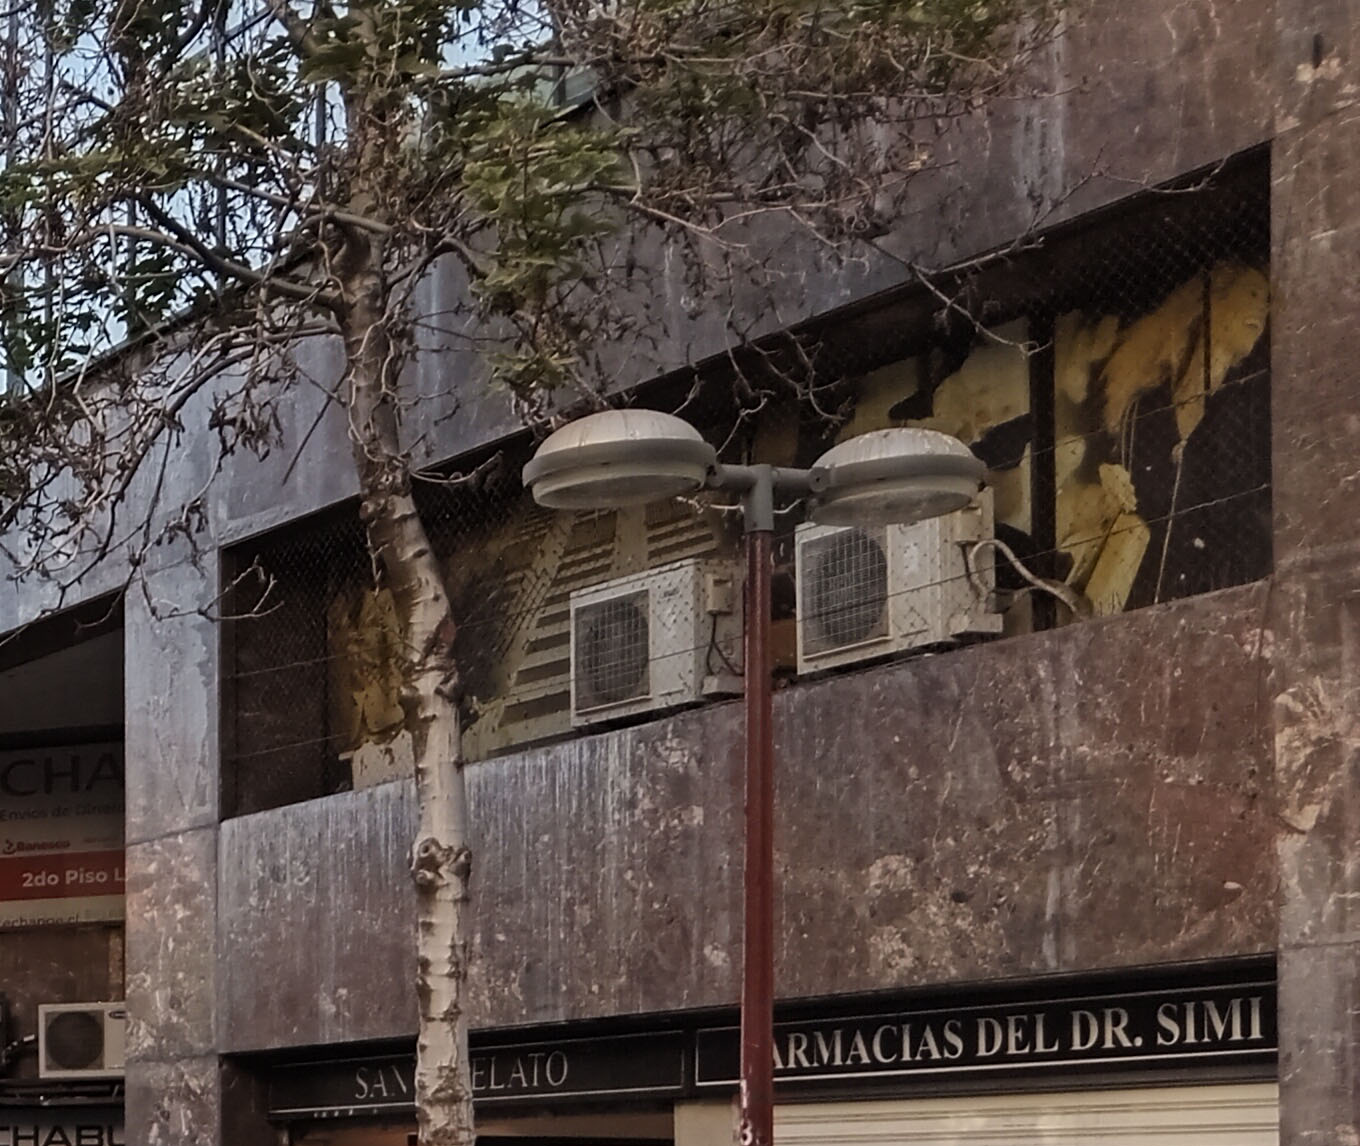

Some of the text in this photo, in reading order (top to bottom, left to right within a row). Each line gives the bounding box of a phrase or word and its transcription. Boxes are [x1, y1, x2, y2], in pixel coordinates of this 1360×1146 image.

[22, 871, 60, 888] 2do
[65, 867, 108, 885] Piso
[772, 996, 1265, 1069] RMACIAS DEL DR. SIMI
[472, 1050, 569, 1091] ELATO
